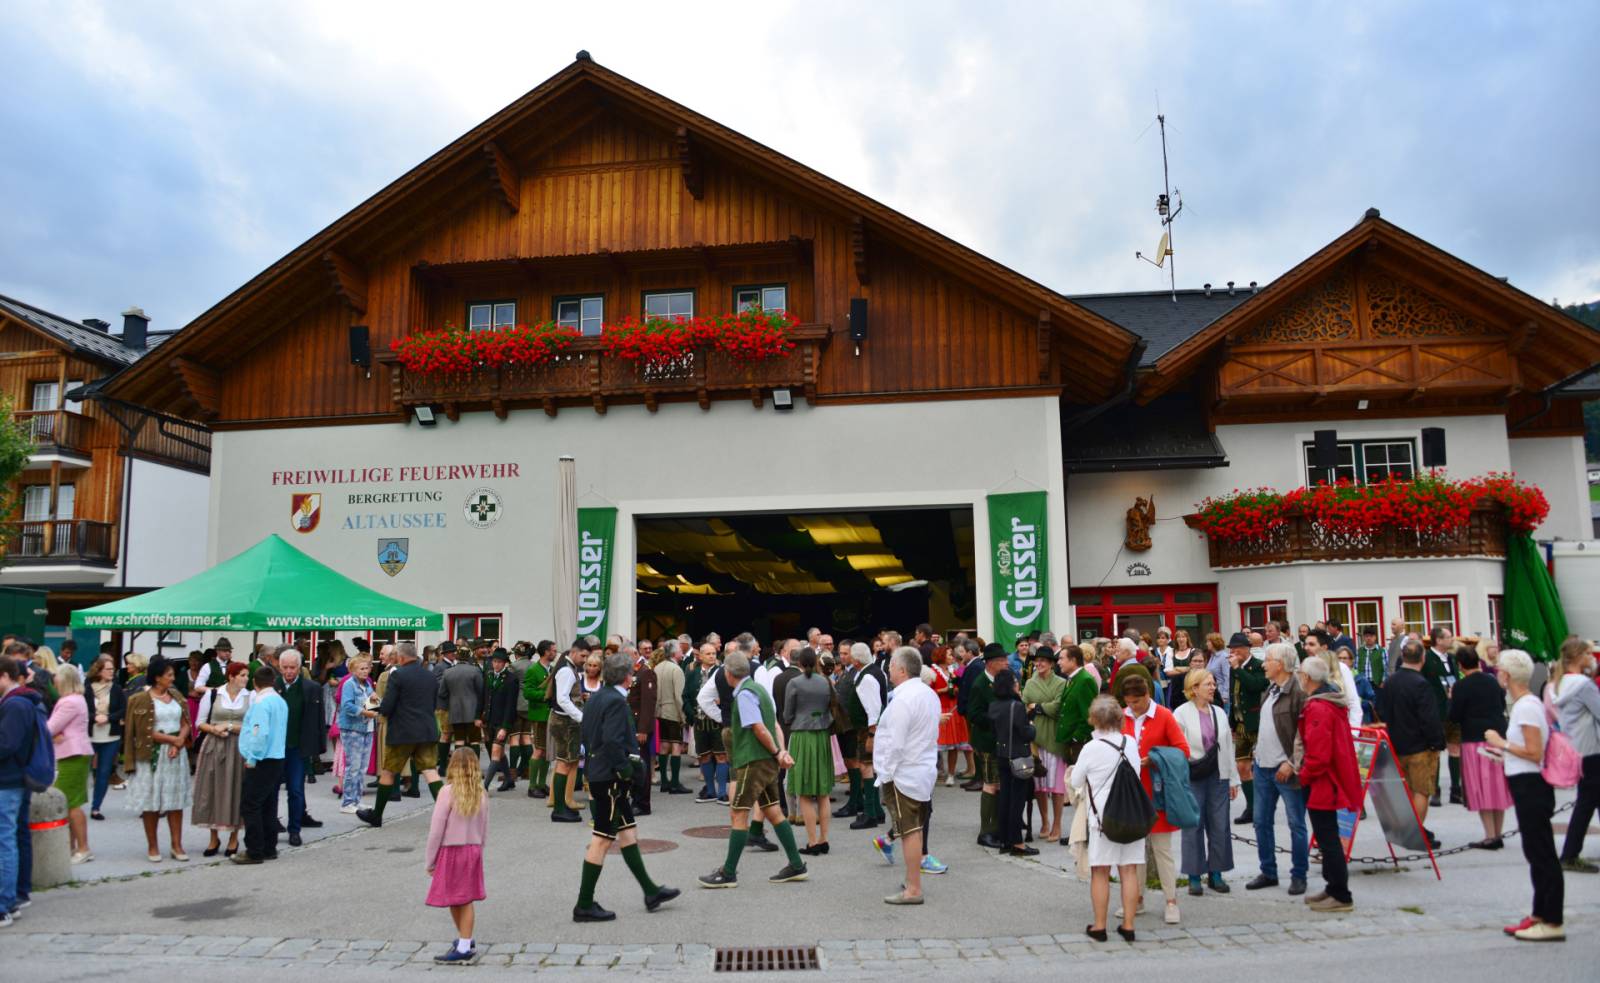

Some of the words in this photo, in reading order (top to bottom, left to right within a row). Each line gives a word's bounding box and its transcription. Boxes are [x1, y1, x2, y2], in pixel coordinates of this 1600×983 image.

[271, 467, 393, 485] FREIWILLIGE
[399, 462, 520, 481] FEUERWEHR
[348, 490, 442, 505] BERGRETTUNG
[341, 512, 447, 530] ALTAUSSEE
[999, 516, 1044, 626] Gösser
[84, 613, 232, 626] www.schrottshammer.at
[266, 614, 427, 628] www.schrottshammer.at
